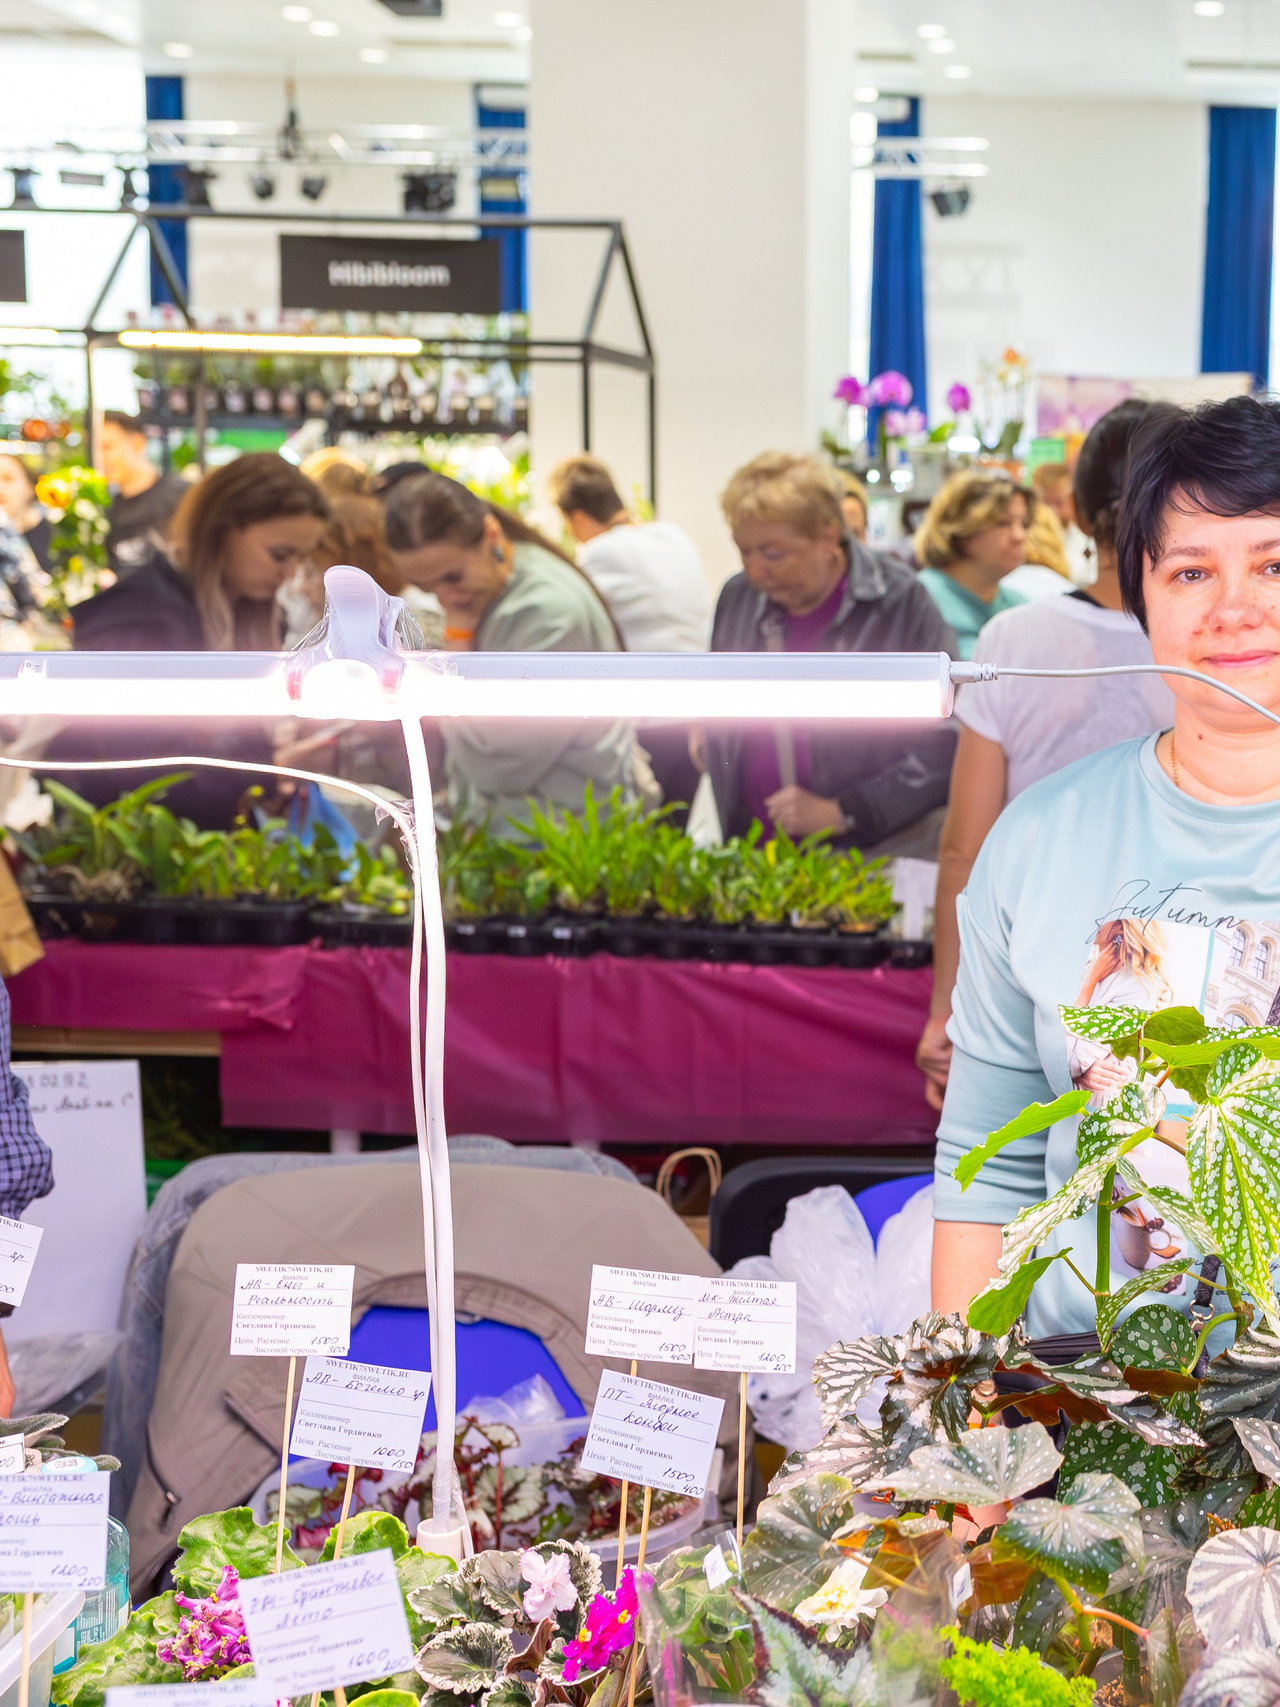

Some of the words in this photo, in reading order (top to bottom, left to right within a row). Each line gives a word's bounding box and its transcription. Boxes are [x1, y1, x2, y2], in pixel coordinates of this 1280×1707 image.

[1086, 879, 1243, 944] Autumn
[609, 1269, 680, 1282] SWETIK7SWETIK.RU
[710, 1280, 778, 1290] SWETIK7SWETIK.RU
[274, 1322, 316, 1331] Гордиенко
[590, 1322, 623, 1332] Светлана
[624, 1325, 662, 1336] Гордиенко
[659, 1342, 686, 1352] 1500
[670, 1353, 691, 1361] 400
[325, 1359, 411, 1378] SWETIK7SWETIK.RU
[620, 1376, 704, 1403] SWETIK7SWETIK.RU
[298, 1418, 336, 1432] Светлана
[338, 1425, 382, 1439] Гордиенко
[373, 1447, 405, 1457] 1000
[591, 1434, 629, 1450] Светлана
[630, 1444, 673, 1460] Гордиенко
[391, 1460, 413, 1469] 150
[662, 1467, 695, 1482] 1500
[683, 1484, 704, 1495] 400
